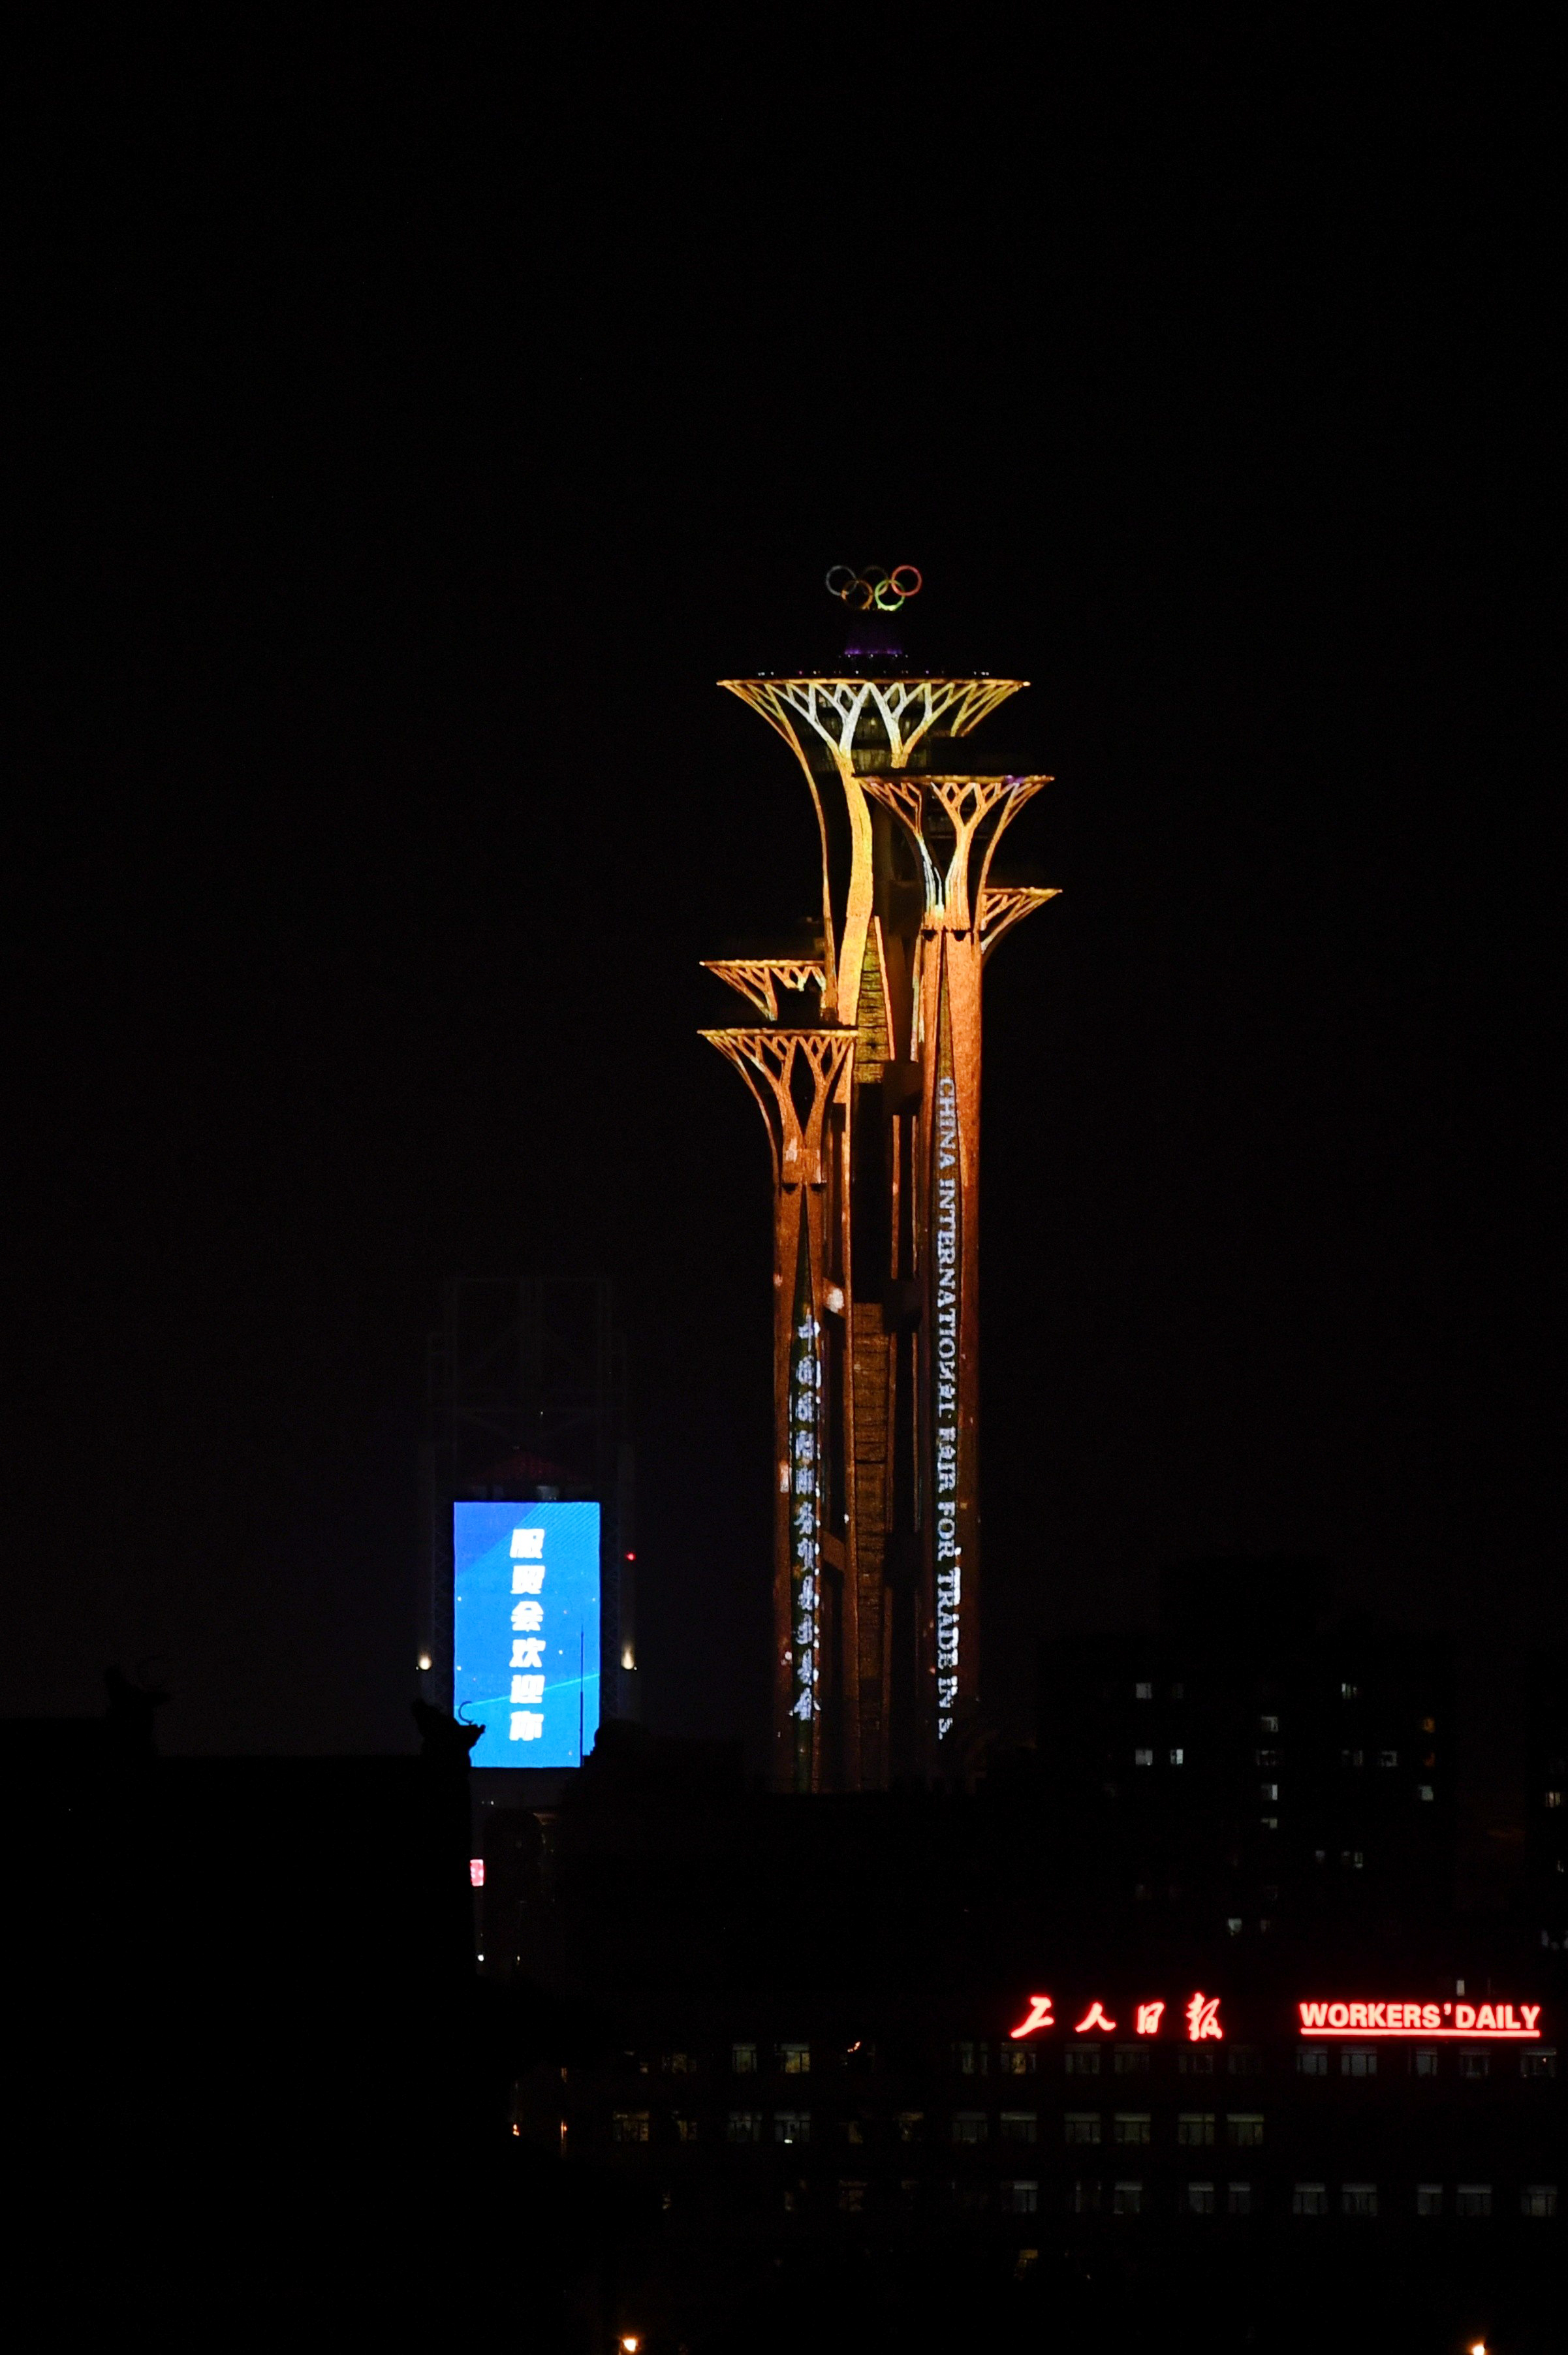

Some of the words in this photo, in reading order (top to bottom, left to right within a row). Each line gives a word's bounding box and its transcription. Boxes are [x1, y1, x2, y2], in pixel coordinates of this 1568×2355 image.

[939, 1077, 956, 1169] CHINA
[937, 1178, 956, 1417] INTERNATIONAL
[937, 1426, 956, 1493] FAIR
[937, 1502, 956, 1561] FOR
[509, 1528, 546, 1741] 服贸会欢迎你
[937, 1567, 960, 1669] TRADE
